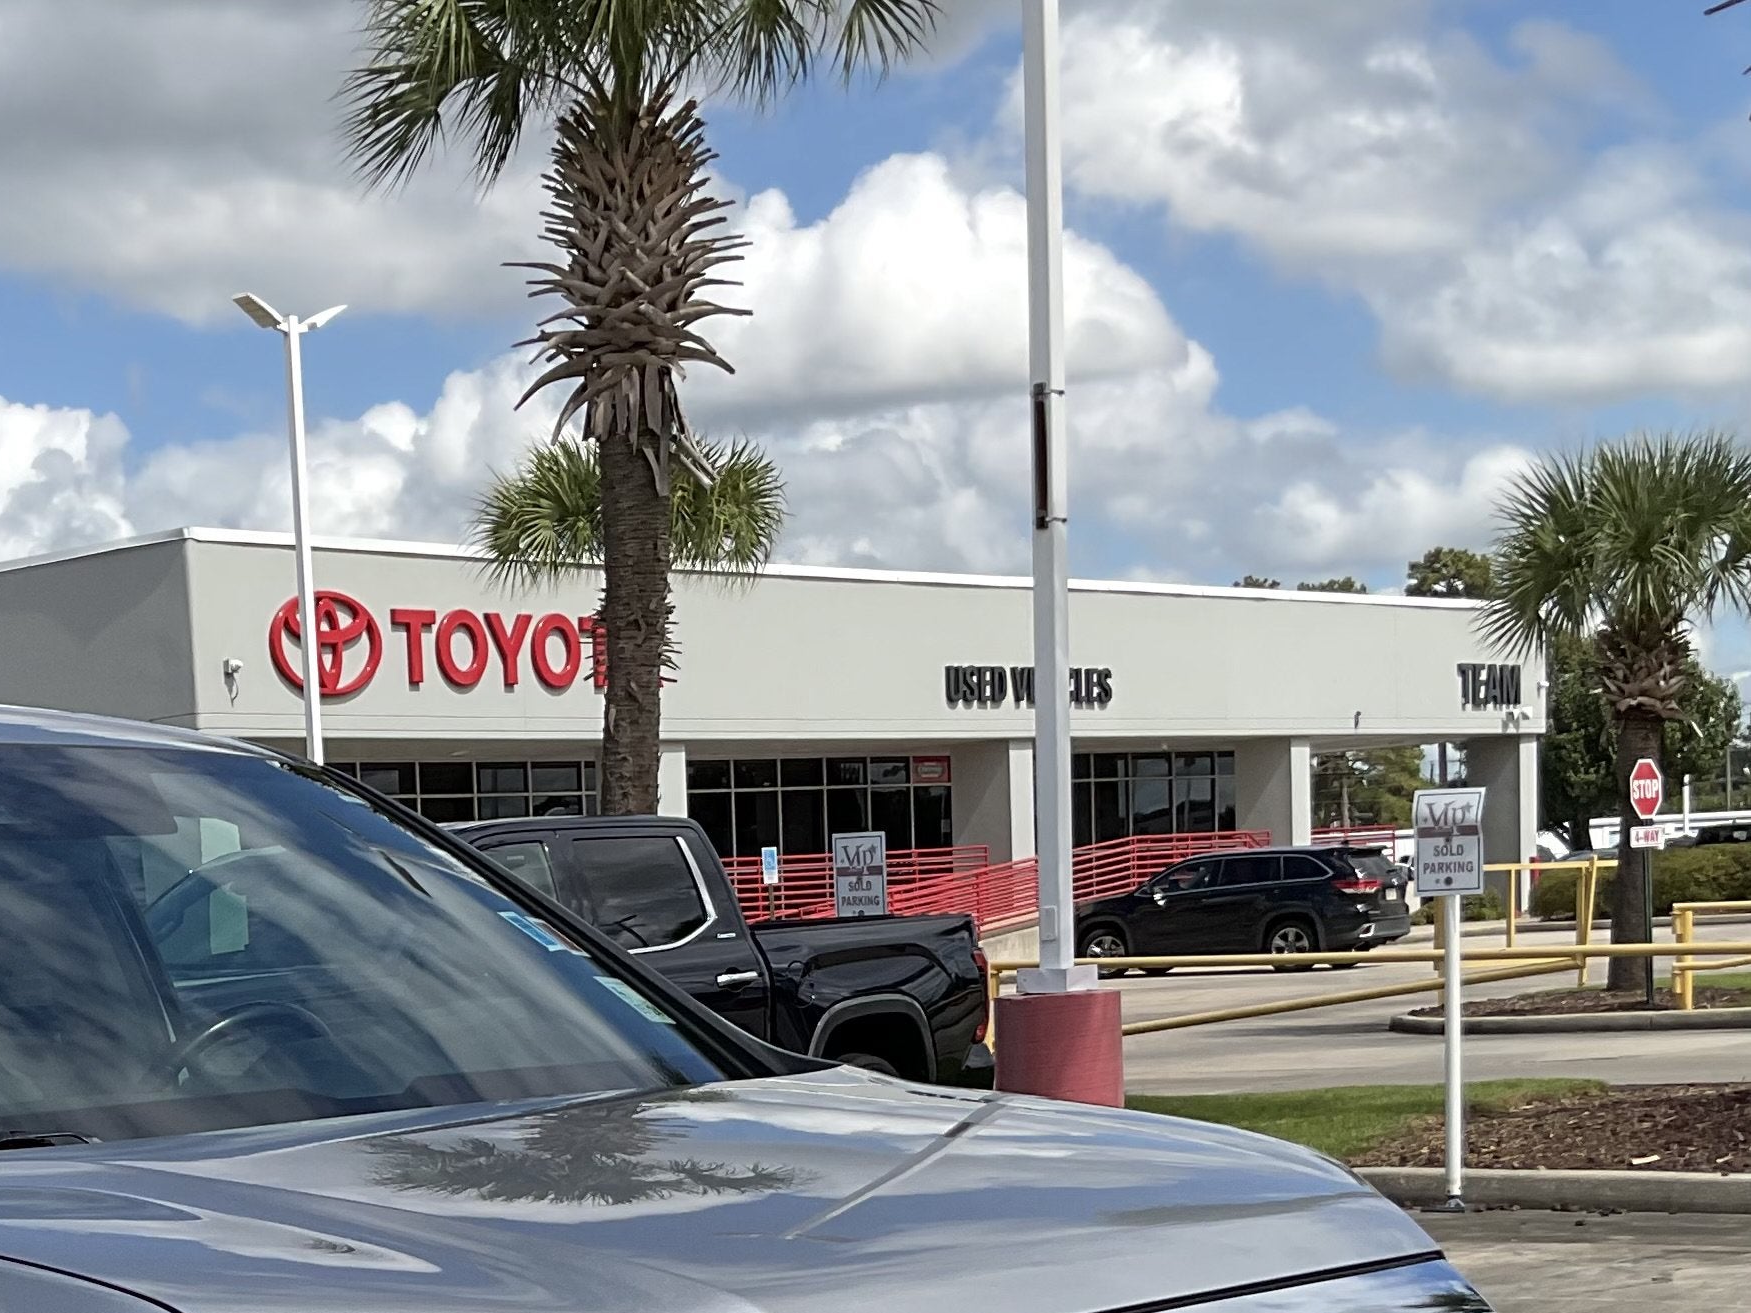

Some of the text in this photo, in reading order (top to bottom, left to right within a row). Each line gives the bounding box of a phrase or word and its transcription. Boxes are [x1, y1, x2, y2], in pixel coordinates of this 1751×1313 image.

[390, 608, 663, 689] TOYOT
[945, 665, 1007, 703] USED
[1457, 663, 1521, 705] TEAM
[1632, 778, 1659, 800] STOP
[1634, 829, 1660, 843] 4-WAY
[1433, 844, 1464, 857] SOLD
[1423, 861, 1474, 874] PARKING
[848, 880, 872, 892] SOLD
[841, 895, 880, 906] PARKING
